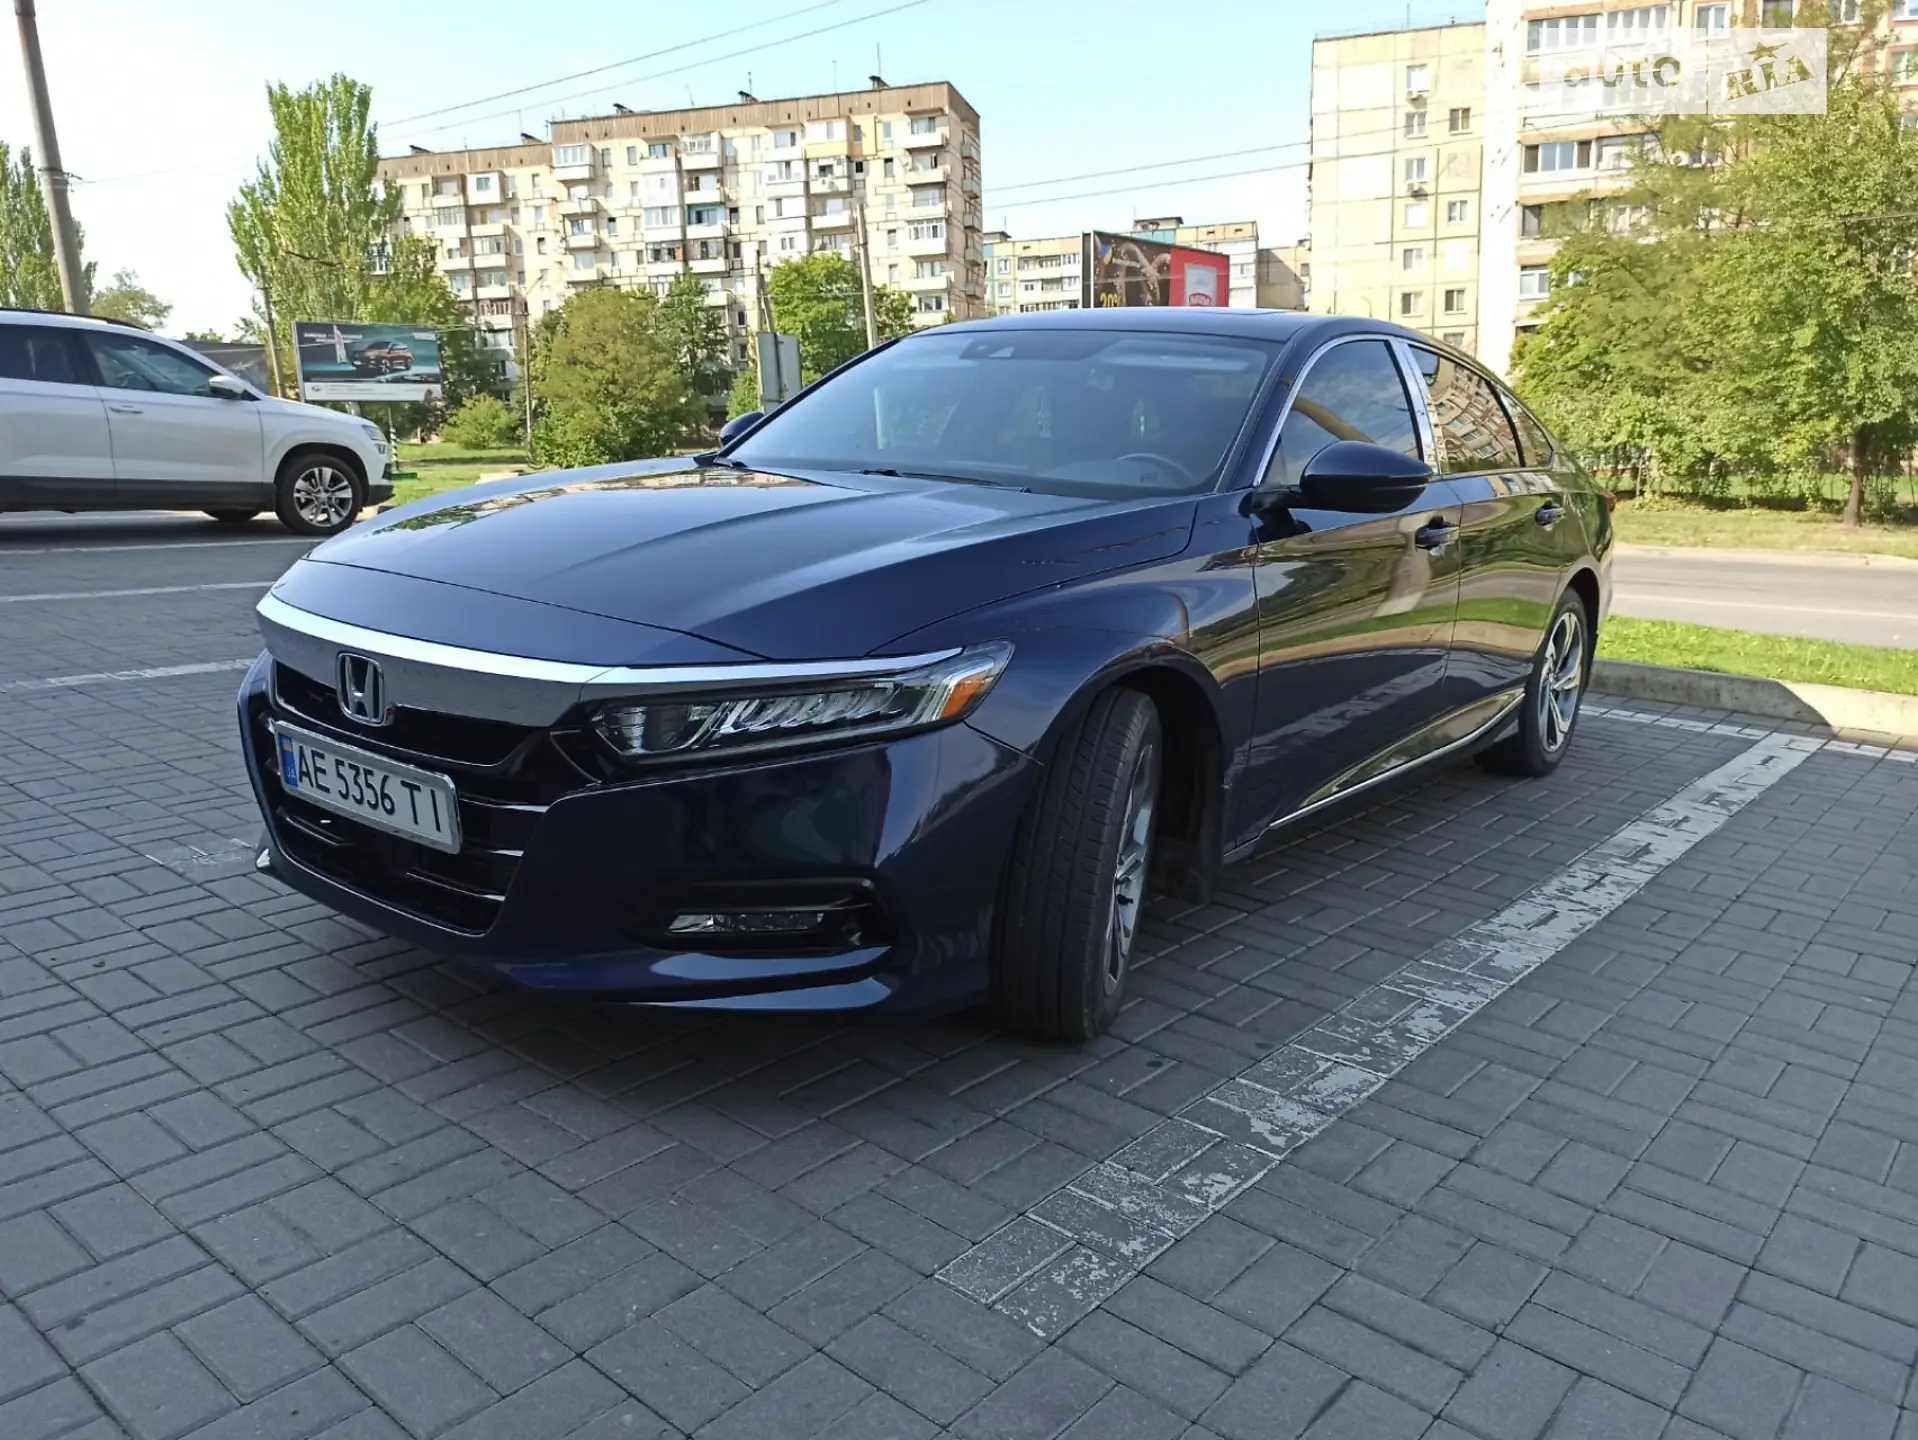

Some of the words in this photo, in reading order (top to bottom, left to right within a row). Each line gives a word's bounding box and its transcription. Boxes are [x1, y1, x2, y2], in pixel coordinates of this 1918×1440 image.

[298, 745, 330, 794] AE
[335, 758, 396, 816] 5356
[400, 780, 441, 832] TI
